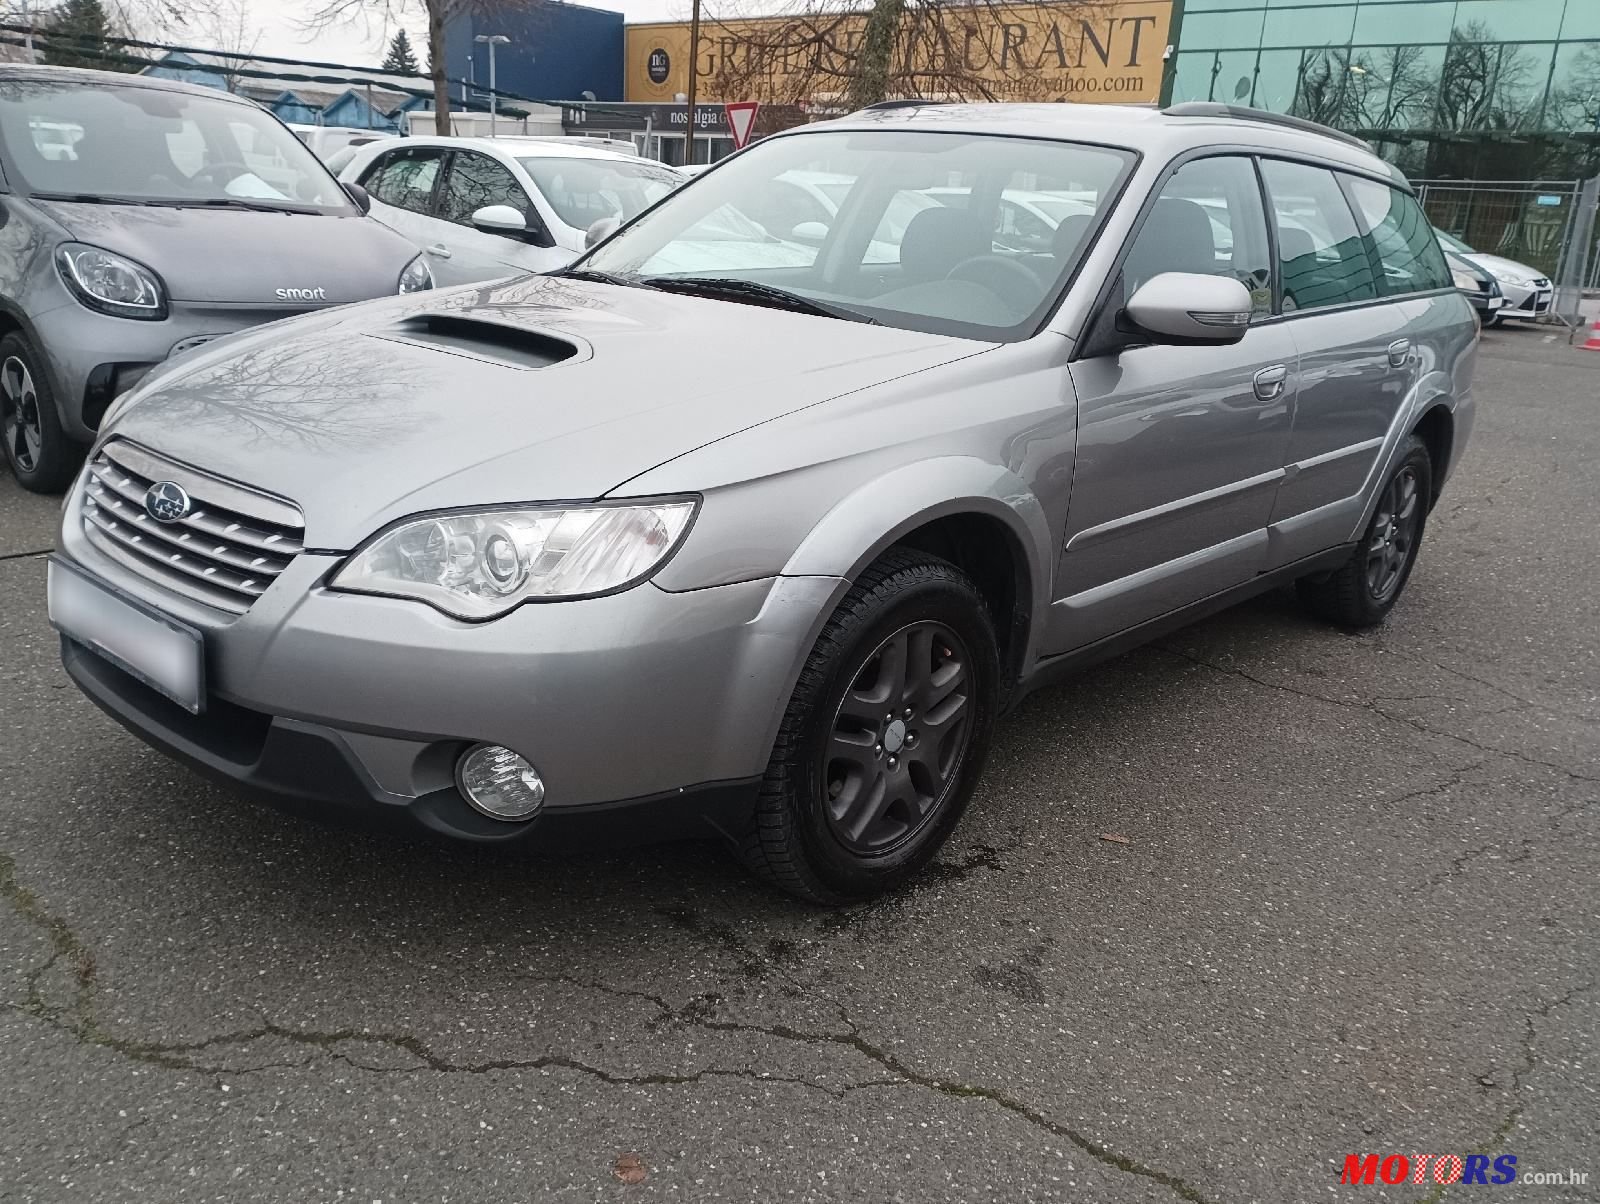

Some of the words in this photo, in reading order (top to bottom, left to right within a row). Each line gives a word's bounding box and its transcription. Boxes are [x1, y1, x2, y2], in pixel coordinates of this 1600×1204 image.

[814, 15, 1156, 76] RETAURANT
[670, 108, 717, 127] nosalgia
[275, 286, 326, 300] smart
